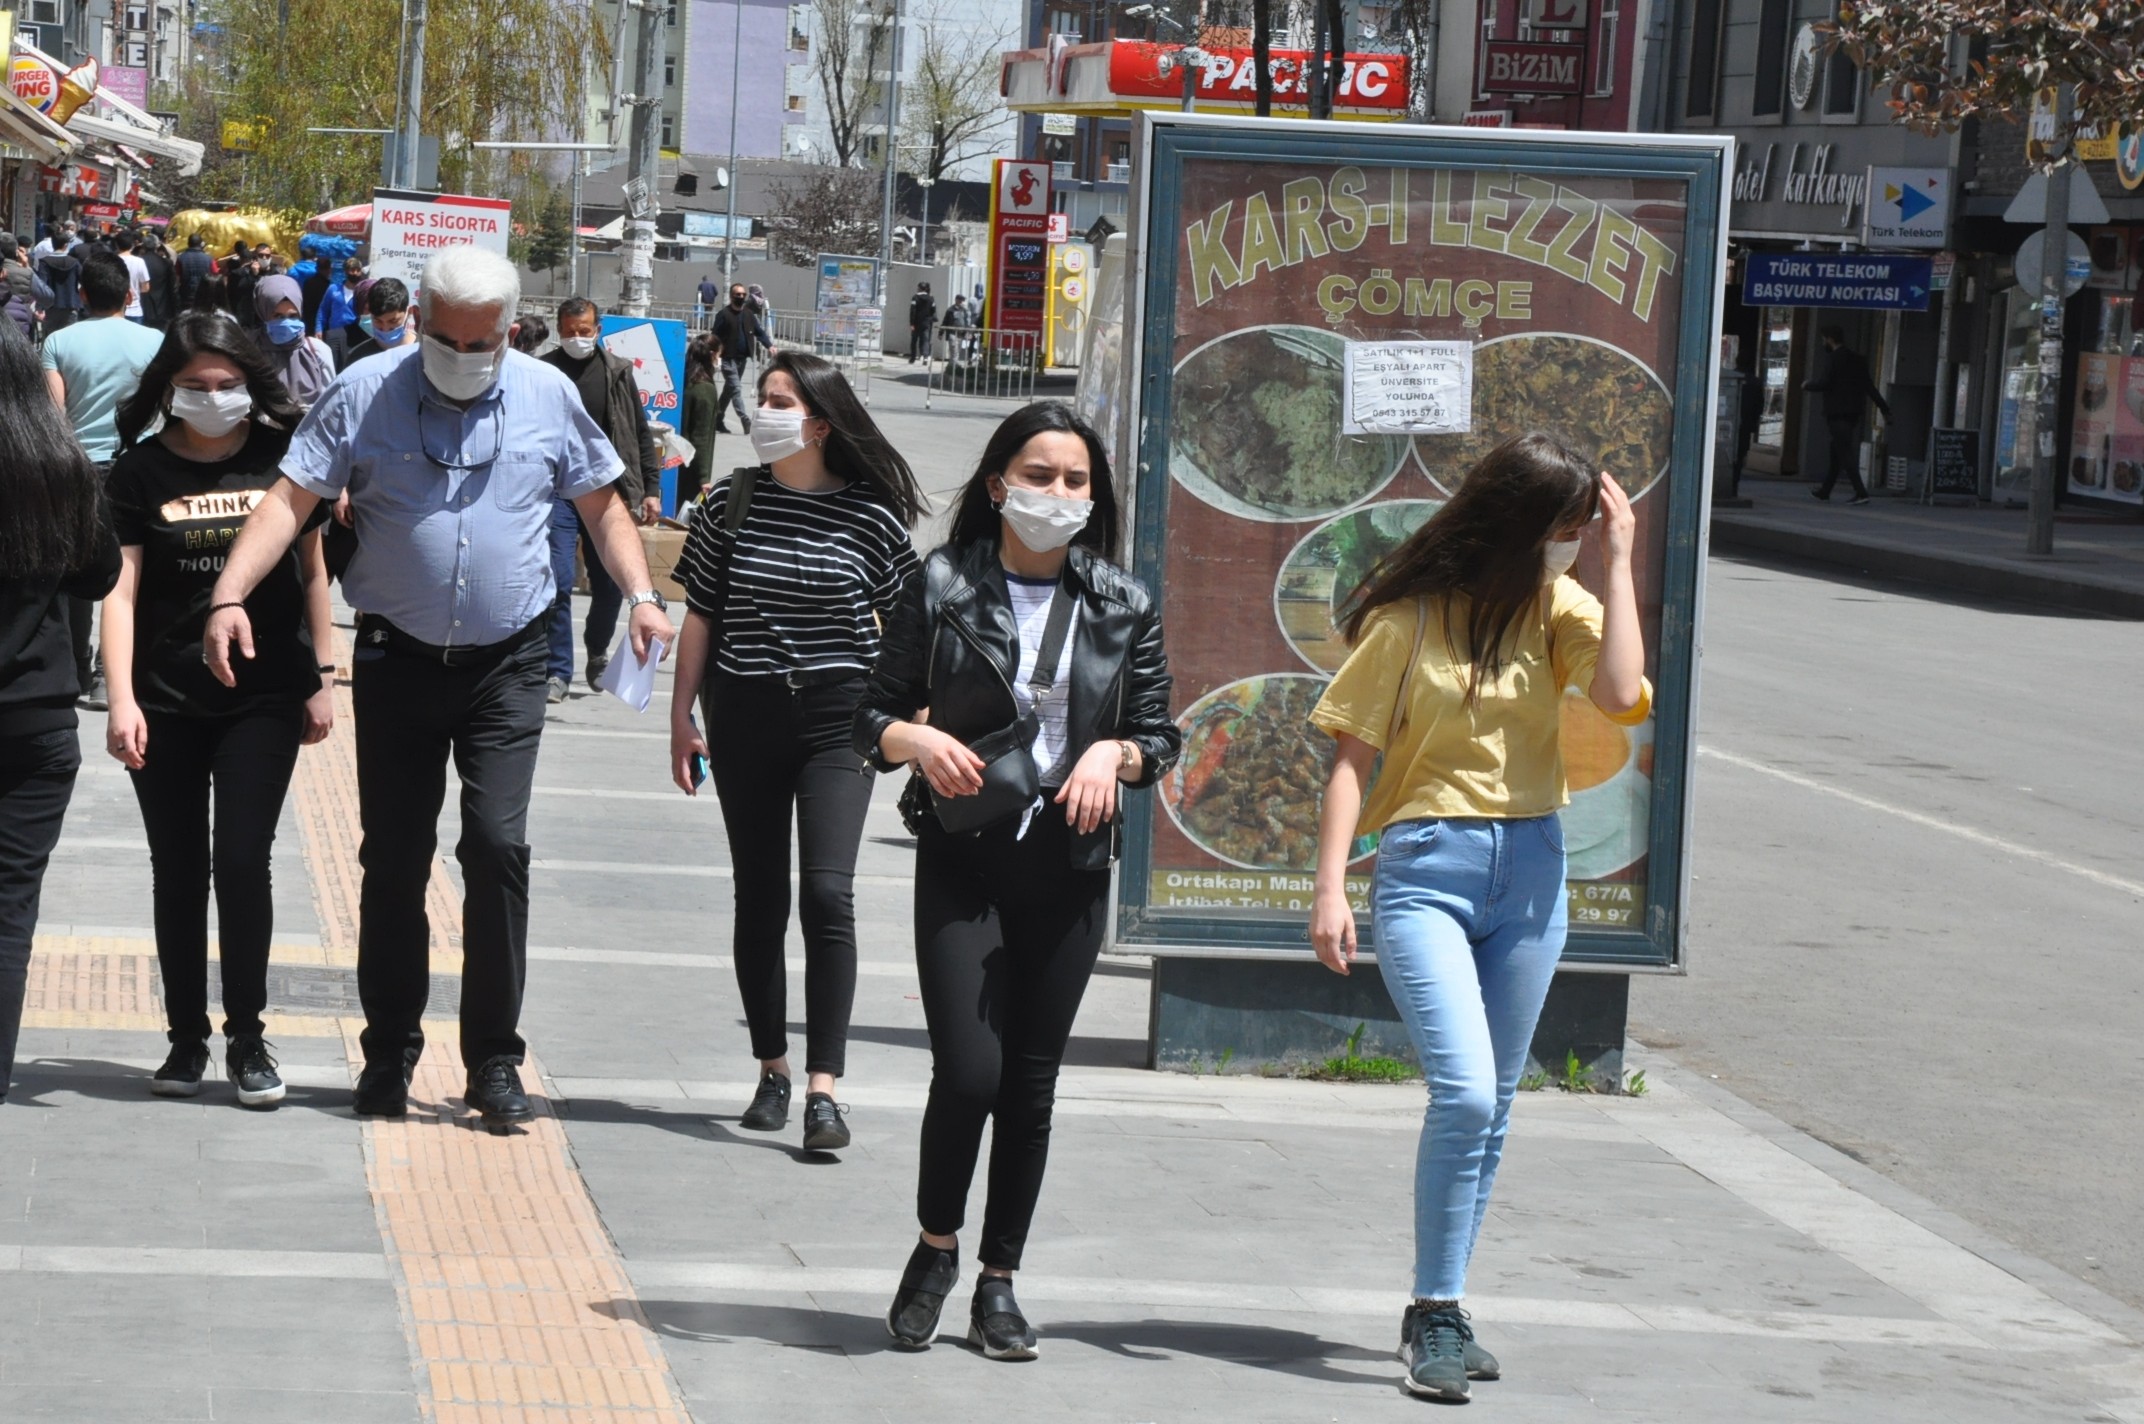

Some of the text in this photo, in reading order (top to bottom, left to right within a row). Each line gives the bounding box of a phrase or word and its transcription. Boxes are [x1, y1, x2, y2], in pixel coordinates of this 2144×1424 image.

[14, 70, 49, 82] URGER
[1202, 55, 1389, 97] PACIIC
[12, 81, 50, 98] ING
[1734, 144, 1773, 201] otel
[381, 209, 498, 233] KARS SİGORTA
[1002, 218, 1043, 228] PACIFIC
[1871, 226, 1943, 238] Türk Telekom
[381, 248, 417, 259] Sigortan
[1430, 168, 1677, 322] LEZZET
[1769, 258, 1890, 279] TÜRK TELEKOM
[1317, 268, 1533, 326] ÇÖMÇE
[1753, 282, 1899, 301] BAŞVURU NOKTASI
[1363, 348, 1404, 357] SATILIK
[1430, 348, 1457, 356] FULL
[1413, 363, 1446, 371] APART
[653, 392, 677, 408] AS
[1386, 392, 1435, 401] YOLUNDA
[1400, 409, 1418, 417] 315
[1420, 409, 1431, 417] 57
[184, 496, 253, 515] THINK
[184, 527, 243, 550] HAP
[176, 556, 225, 573] THOU
[1166, 873, 1262, 892] Ortakapı
[1585, 886, 1632, 901] 67/A
[1577, 907, 1601, 921] 29
[1607, 908, 1632, 922] 97
